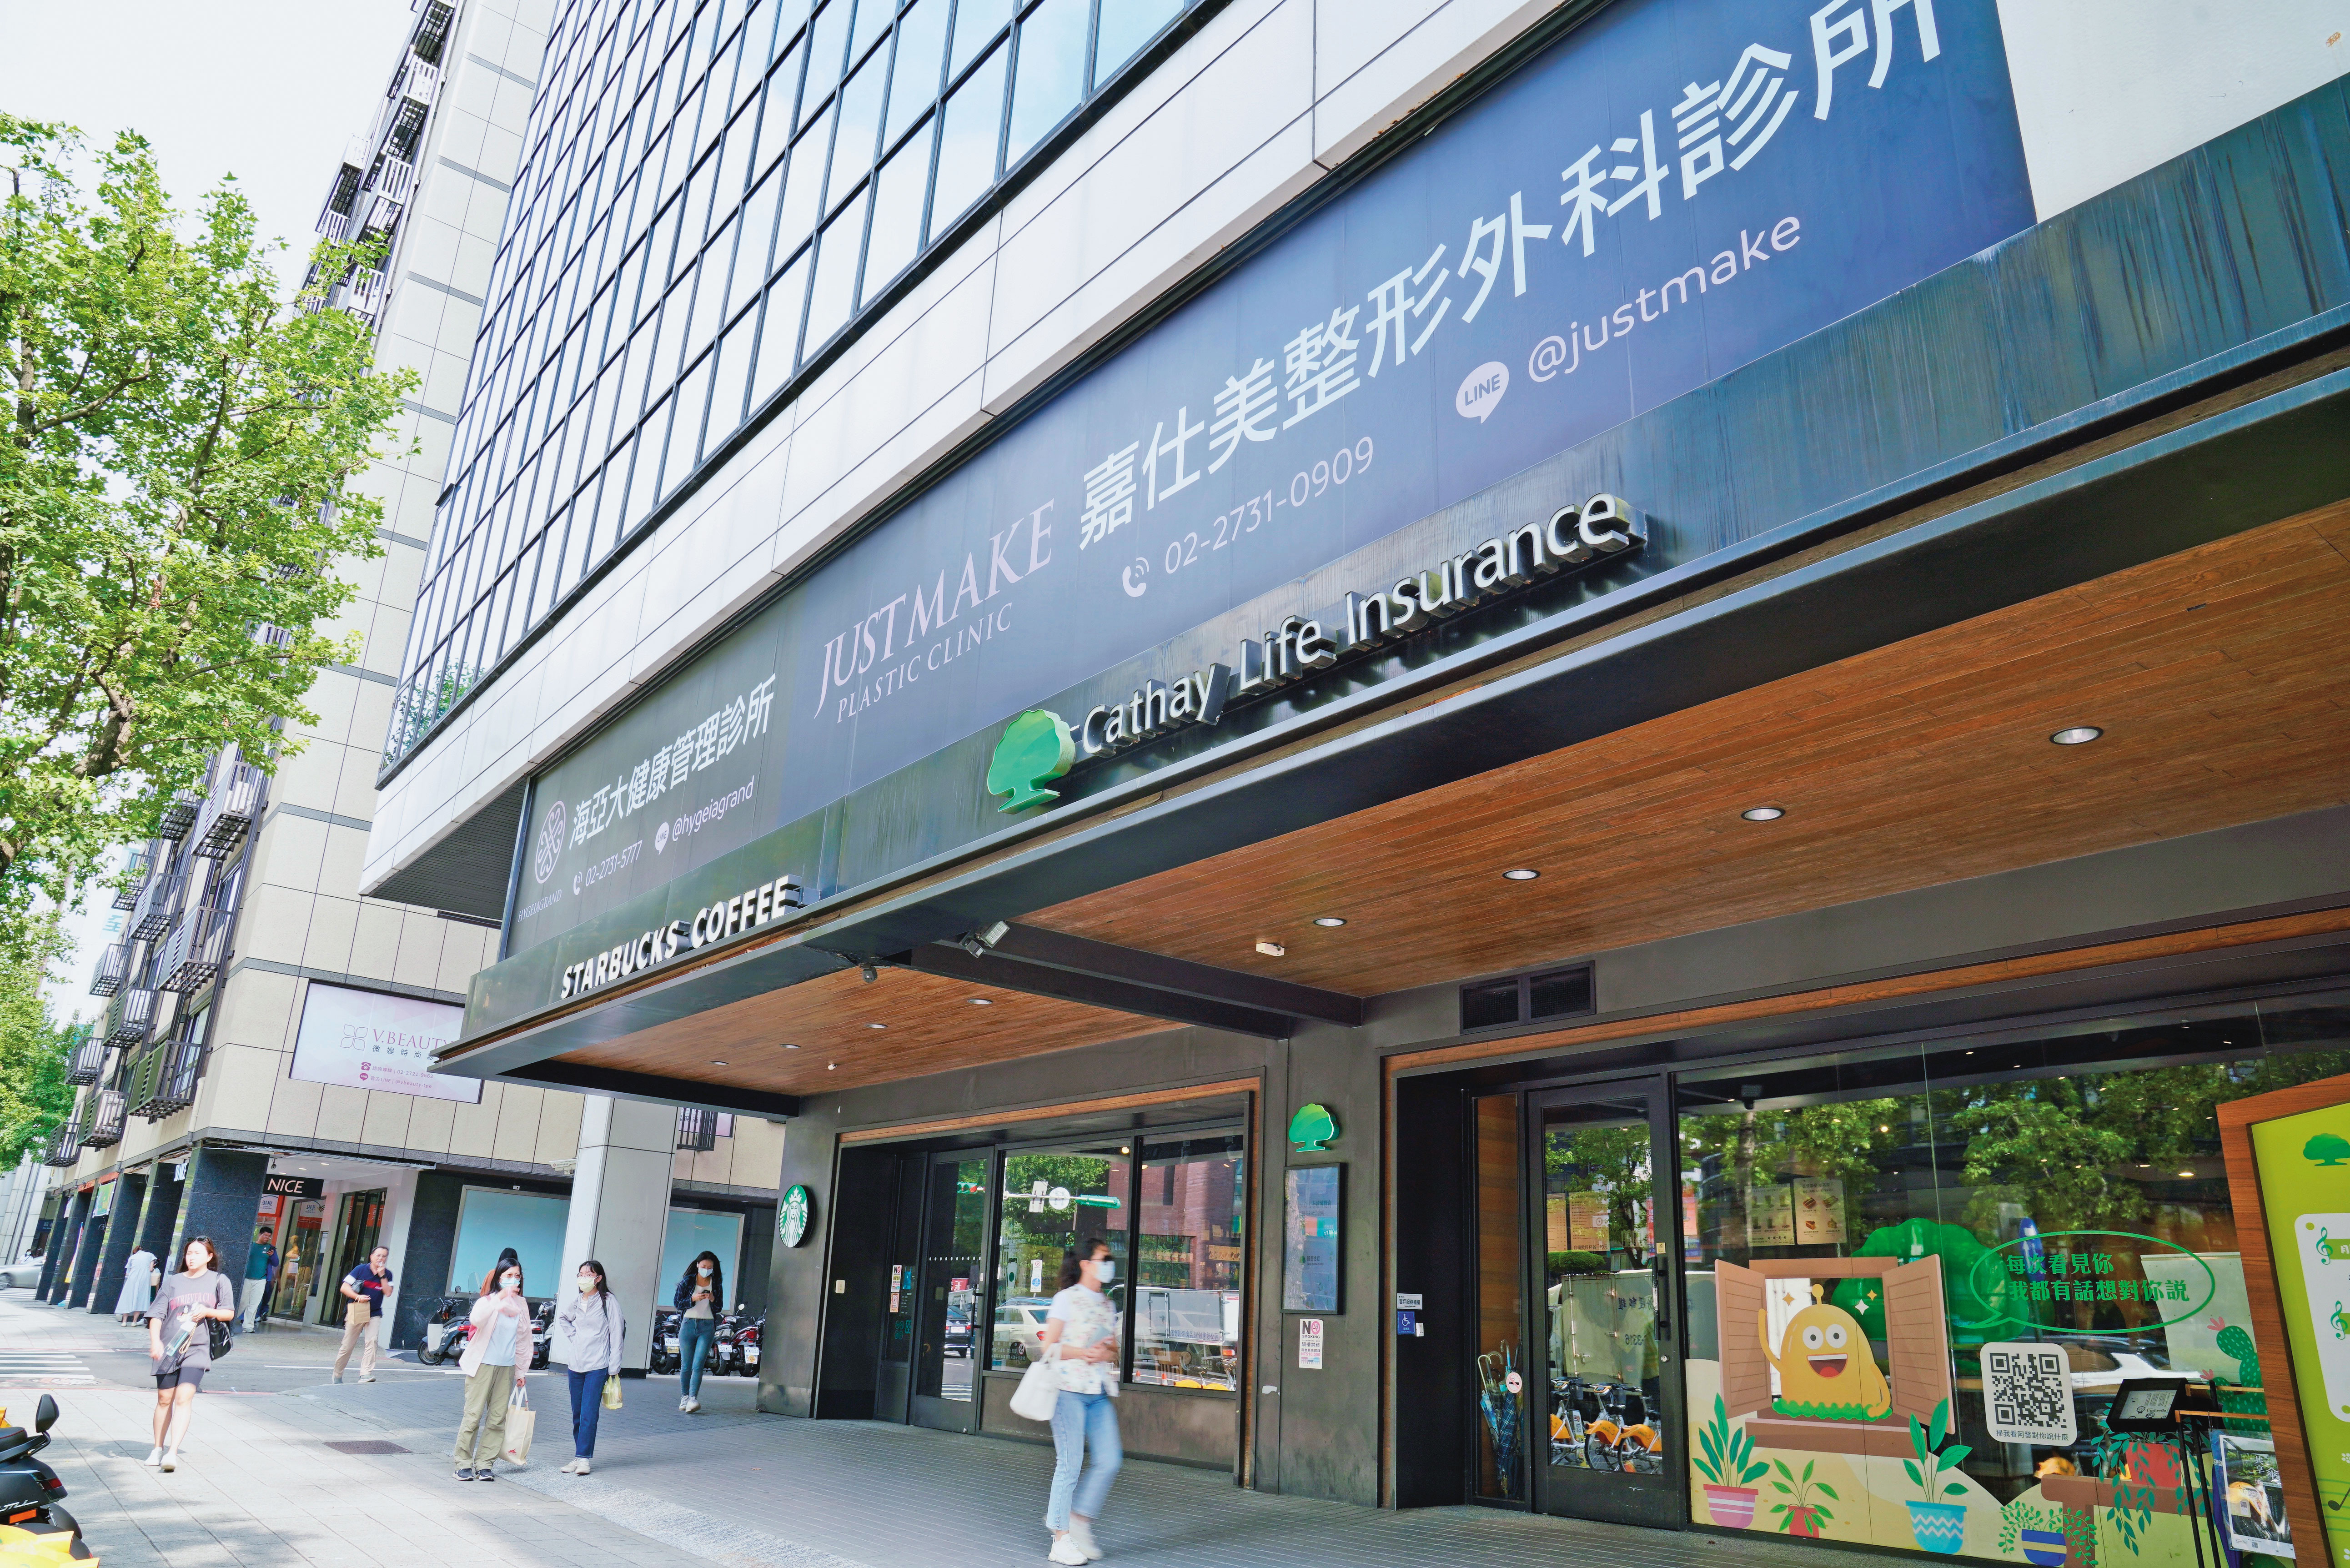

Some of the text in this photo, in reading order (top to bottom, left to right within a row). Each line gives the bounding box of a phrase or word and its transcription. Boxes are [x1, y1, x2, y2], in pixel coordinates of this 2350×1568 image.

[1079, 0, 1940, 551] 嘉仕美整形外科診所
[1527, 216, 1801, 382] @justmake
[1465, 373, 1500, 406] LINE
[1164, 437, 1373, 574] 02-2731-0909
[1082, 493, 1628, 756] Cathay Life Insurance
[836, 603, 1012, 724] PLASTIC CLINIC
[569, 673, 776, 850] 海亞大健康管理診所
[672, 775, 755, 842] @hygeiagrand
[657, 829, 668, 842] LINE
[585, 839, 643, 887] 02-2731-5777
[517, 889, 562, 922] HYGEIAGRAND
[560, 874, 799, 999] STARBUCKS COFFEE
[372, 1045, 440, 1060] 微媞時尚診
[395, 1080, 432, 1088] @vbeauty-tpe
[397, 1069, 433, 1079] 02-2721-9663
[267, 1178, 304, 1193] NICE
[2006, 1253, 2114, 1275] 每次看見你
[1996, 1429, 2069, 1441] 掃我看阿發對你說什麼
